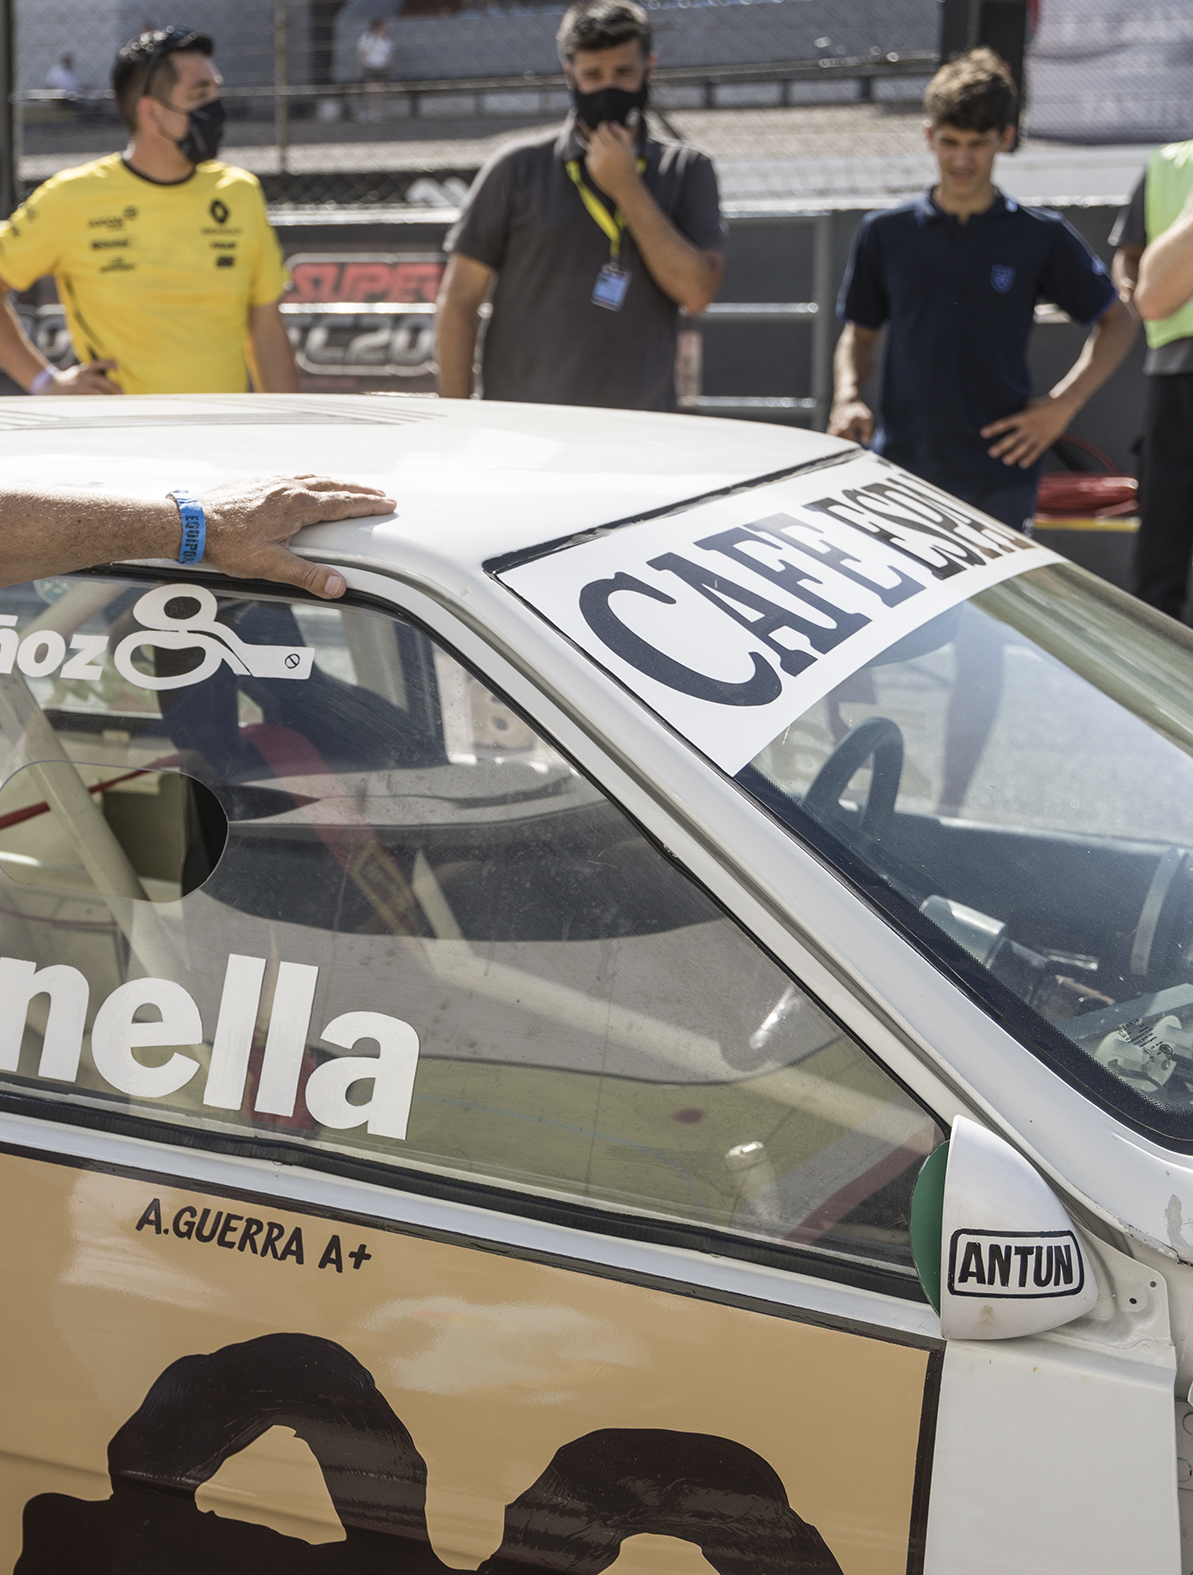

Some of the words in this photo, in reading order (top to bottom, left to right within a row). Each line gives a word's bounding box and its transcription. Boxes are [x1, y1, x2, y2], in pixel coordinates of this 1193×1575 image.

[284, 262, 446, 303] SUPE
[579, 512, 927, 707] CAFE
[136, 1198, 304, 1265] A.GUERRA
[318, 1235, 372, 1273] A+
[958, 1241, 1074, 1288] ANTUN
